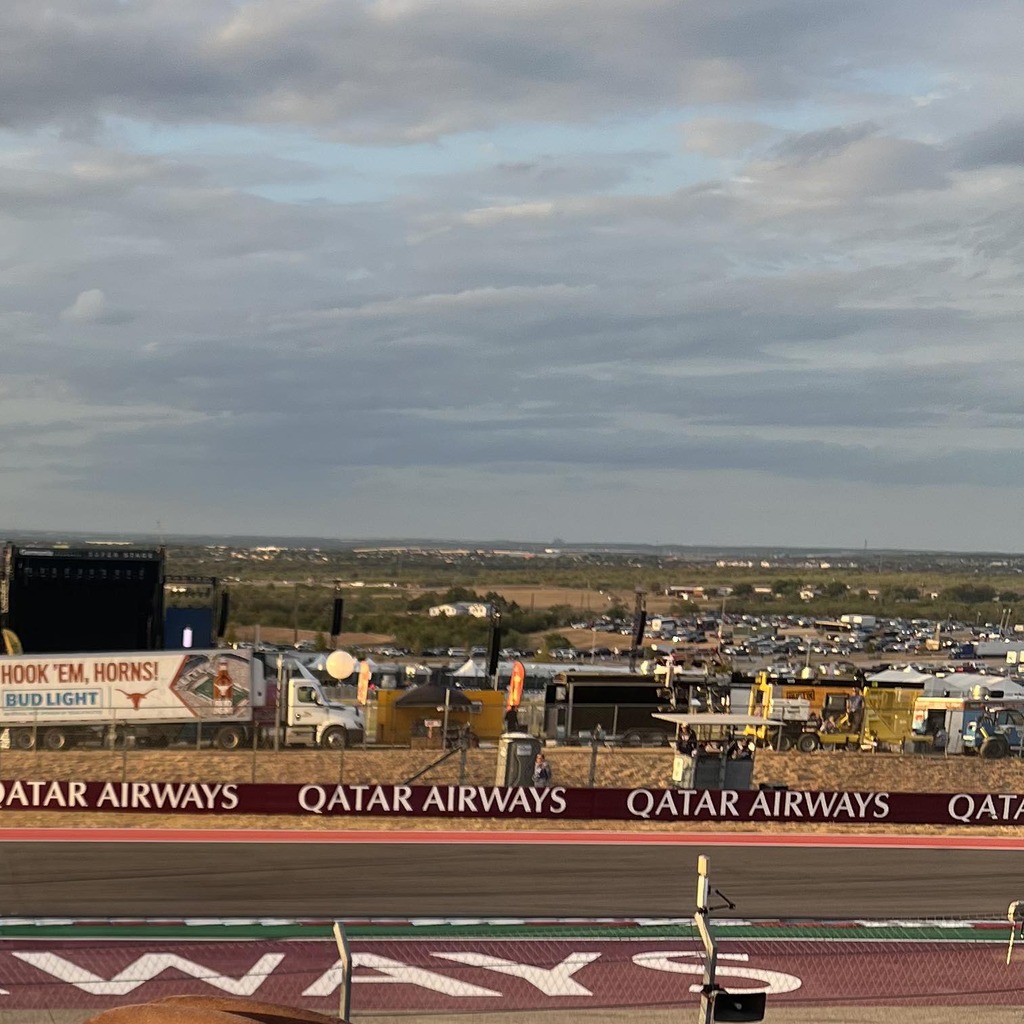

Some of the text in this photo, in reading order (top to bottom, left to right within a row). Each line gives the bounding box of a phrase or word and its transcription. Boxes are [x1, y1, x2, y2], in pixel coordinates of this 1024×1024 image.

[1, 664, 49, 684] HOOK
[94, 661, 159, 683] HORNS!
[6, 692, 98, 706] BUD LIGHT
[97, 782, 239, 809] AIRWAYS
[298, 785, 567, 814] QATAR AIRWAYS
[626, 788, 890, 819] QATAR AIRWAYS
